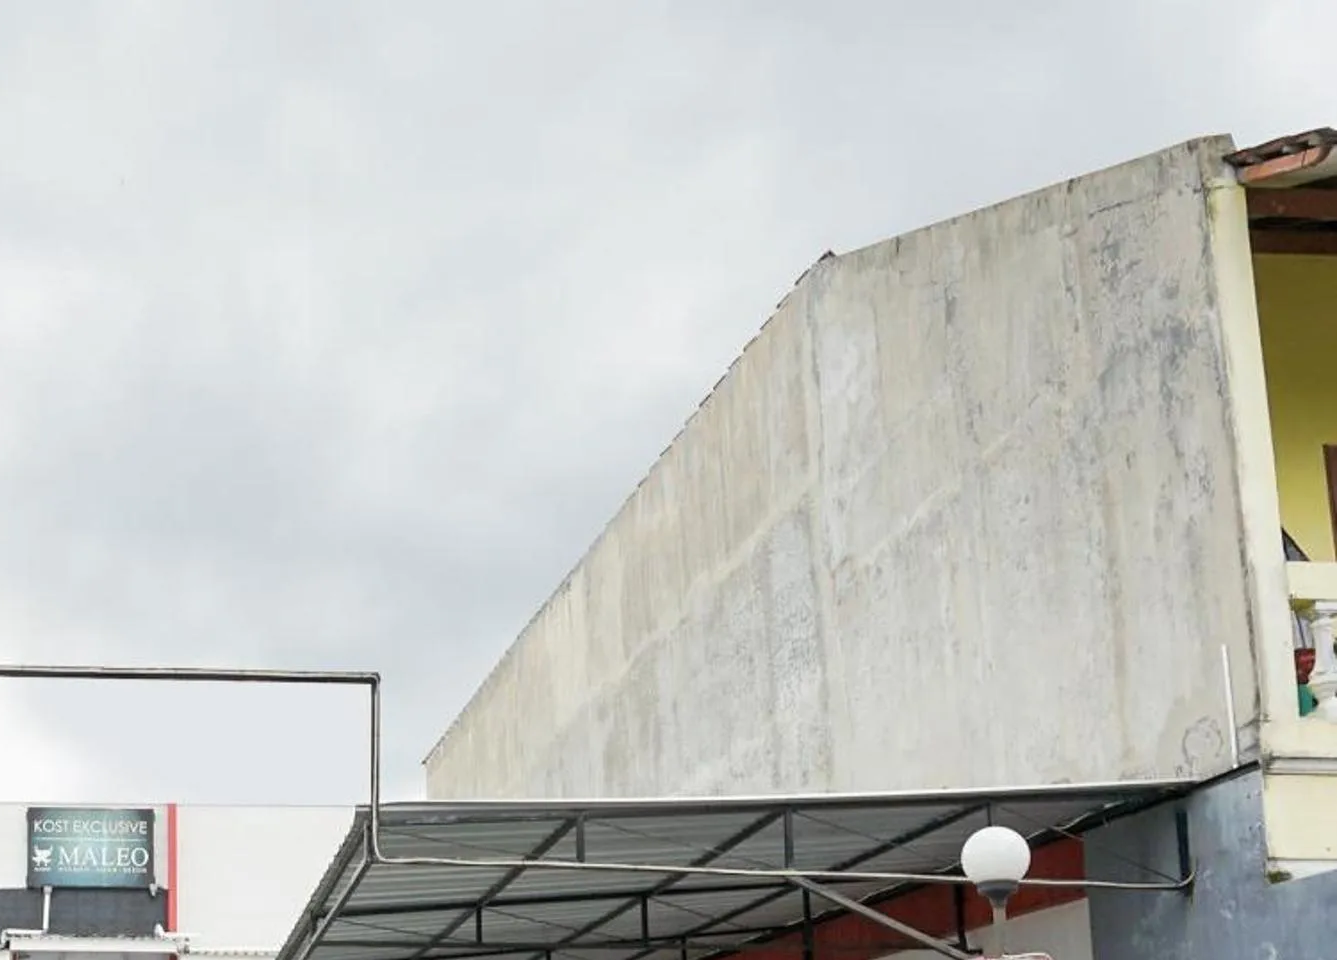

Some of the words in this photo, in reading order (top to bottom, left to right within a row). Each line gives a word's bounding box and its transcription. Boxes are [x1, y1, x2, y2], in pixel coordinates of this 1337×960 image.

[33, 819, 69, 833] KOST
[72, 820, 148, 835] EXCLUSIVE
[58, 845, 150, 868] MALEO
